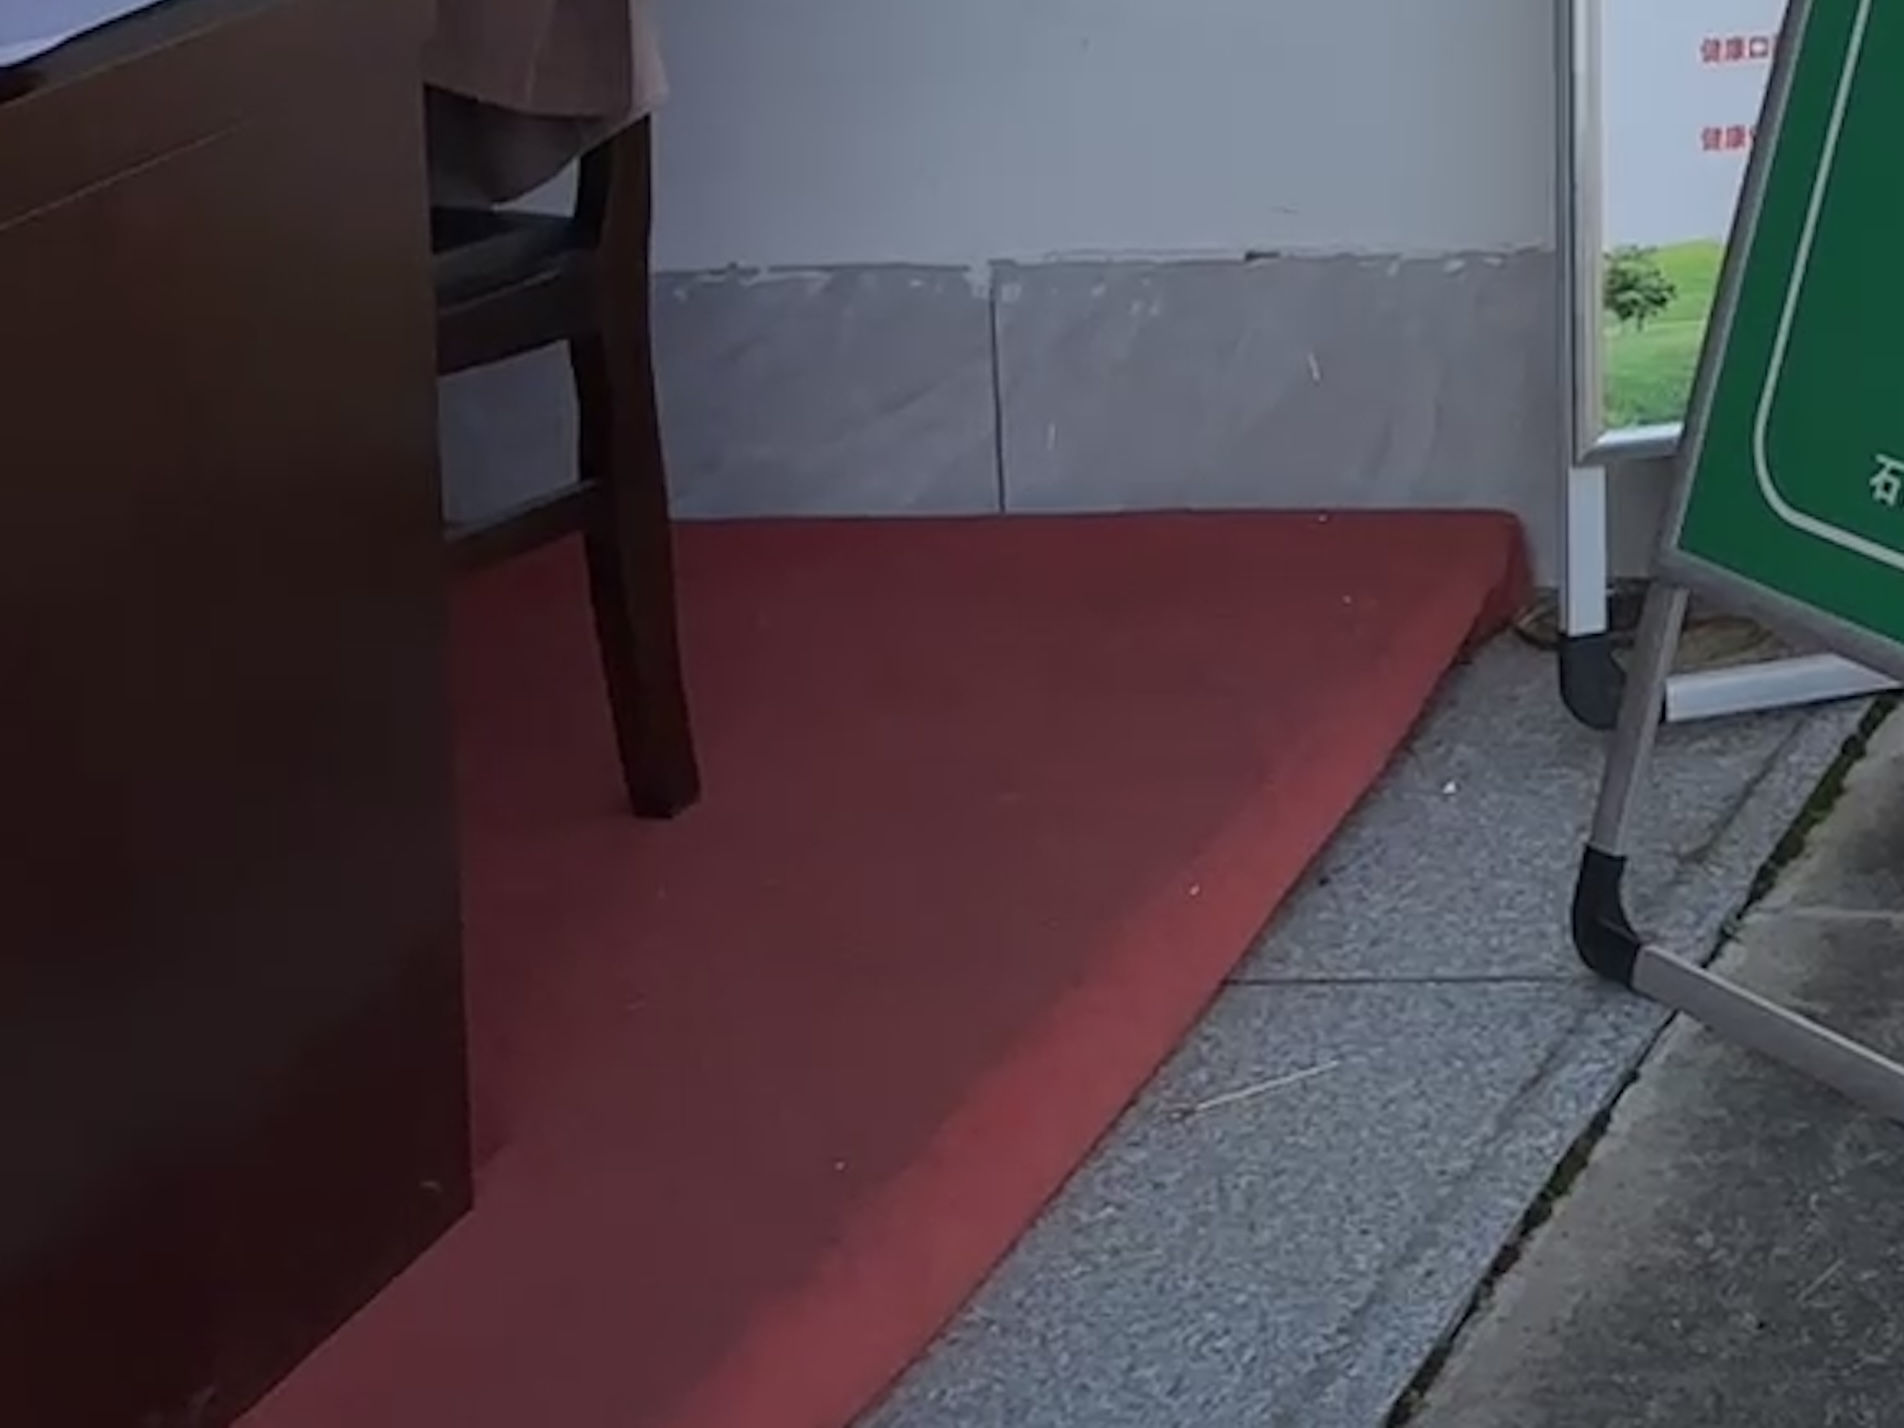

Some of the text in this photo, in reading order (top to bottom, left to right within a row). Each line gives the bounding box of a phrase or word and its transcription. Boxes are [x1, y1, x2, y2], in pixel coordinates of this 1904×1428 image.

[1701, 34, 1781, 63] 健康口
[1701, 125, 1757, 152] 健康
